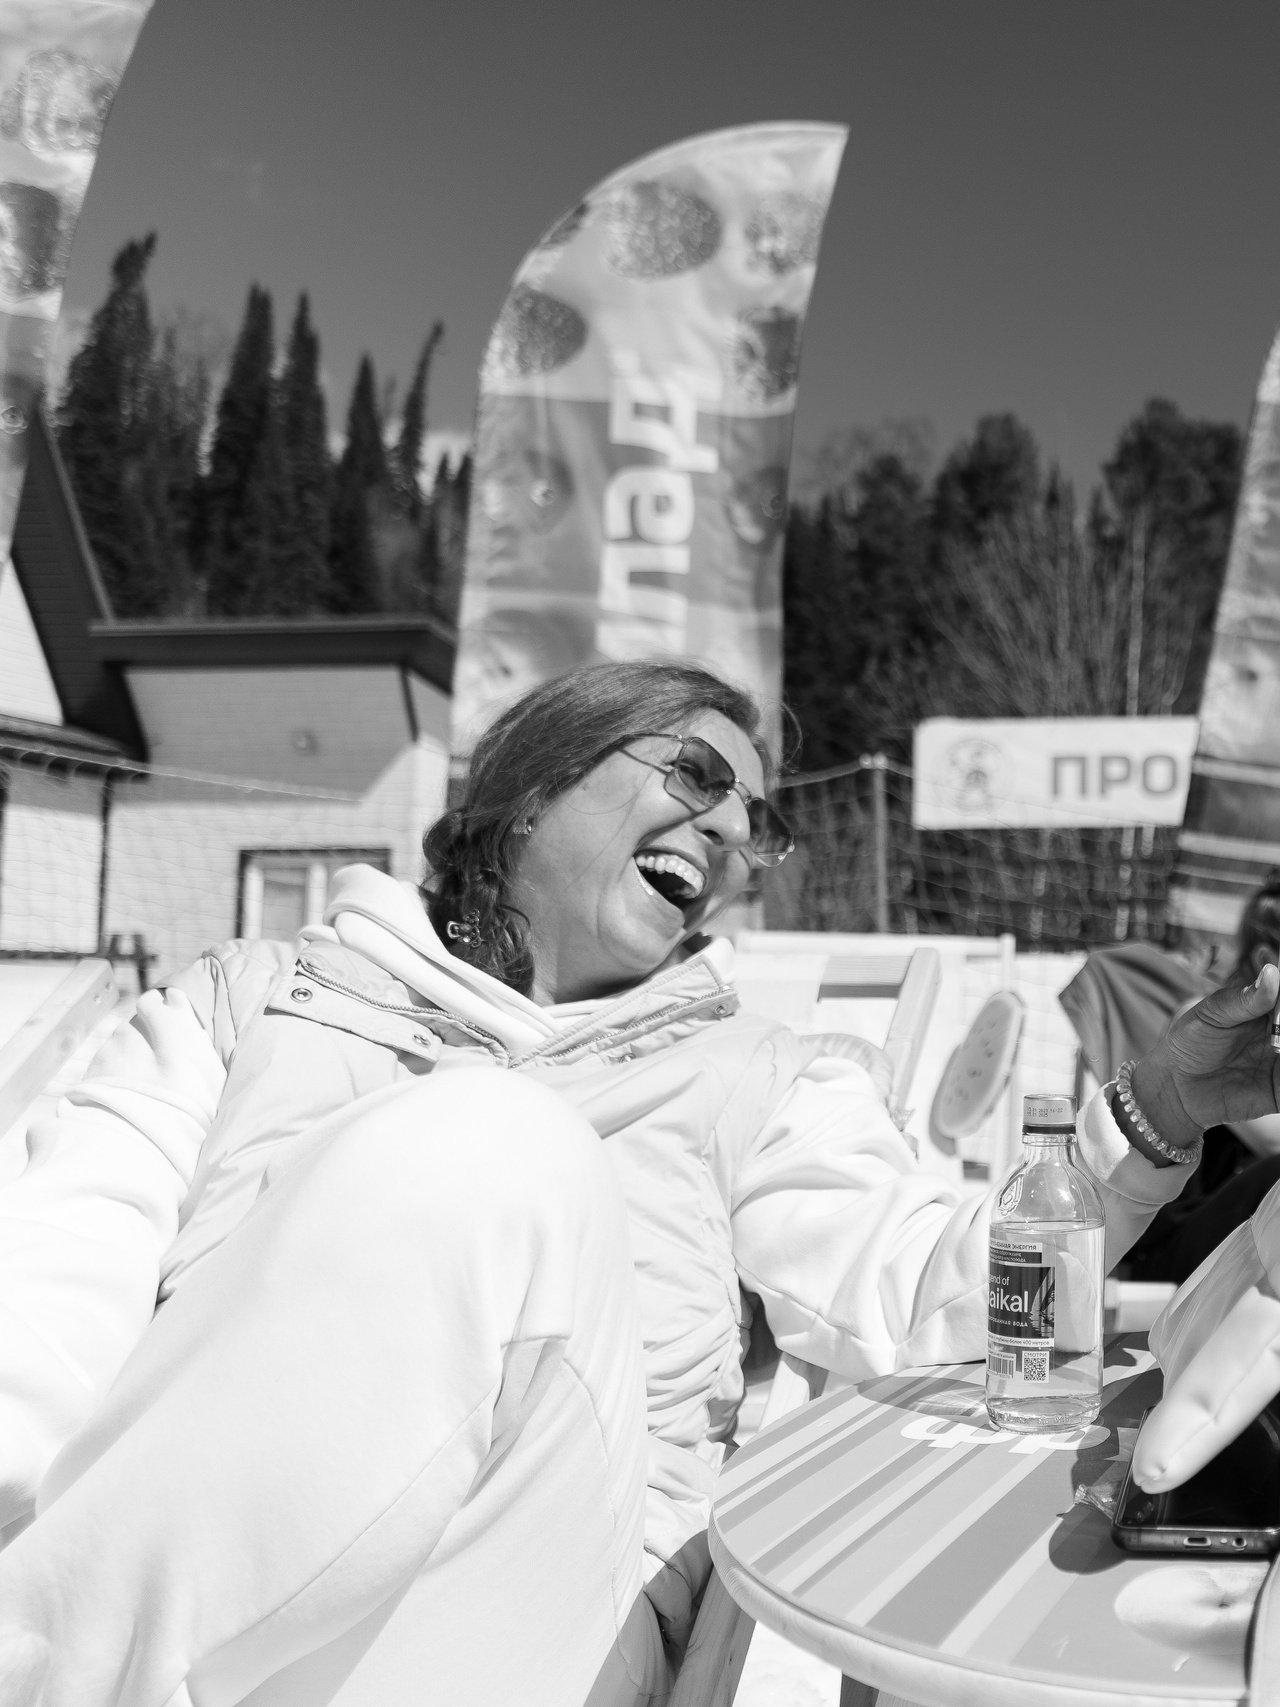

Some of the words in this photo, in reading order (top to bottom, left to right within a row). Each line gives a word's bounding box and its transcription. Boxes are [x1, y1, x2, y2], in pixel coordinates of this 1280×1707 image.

[1001, 1276, 1010, 1286] of
[987, 1287, 1029, 1313] aikal
[1012, 1320, 1029, 1328] ВОДА
